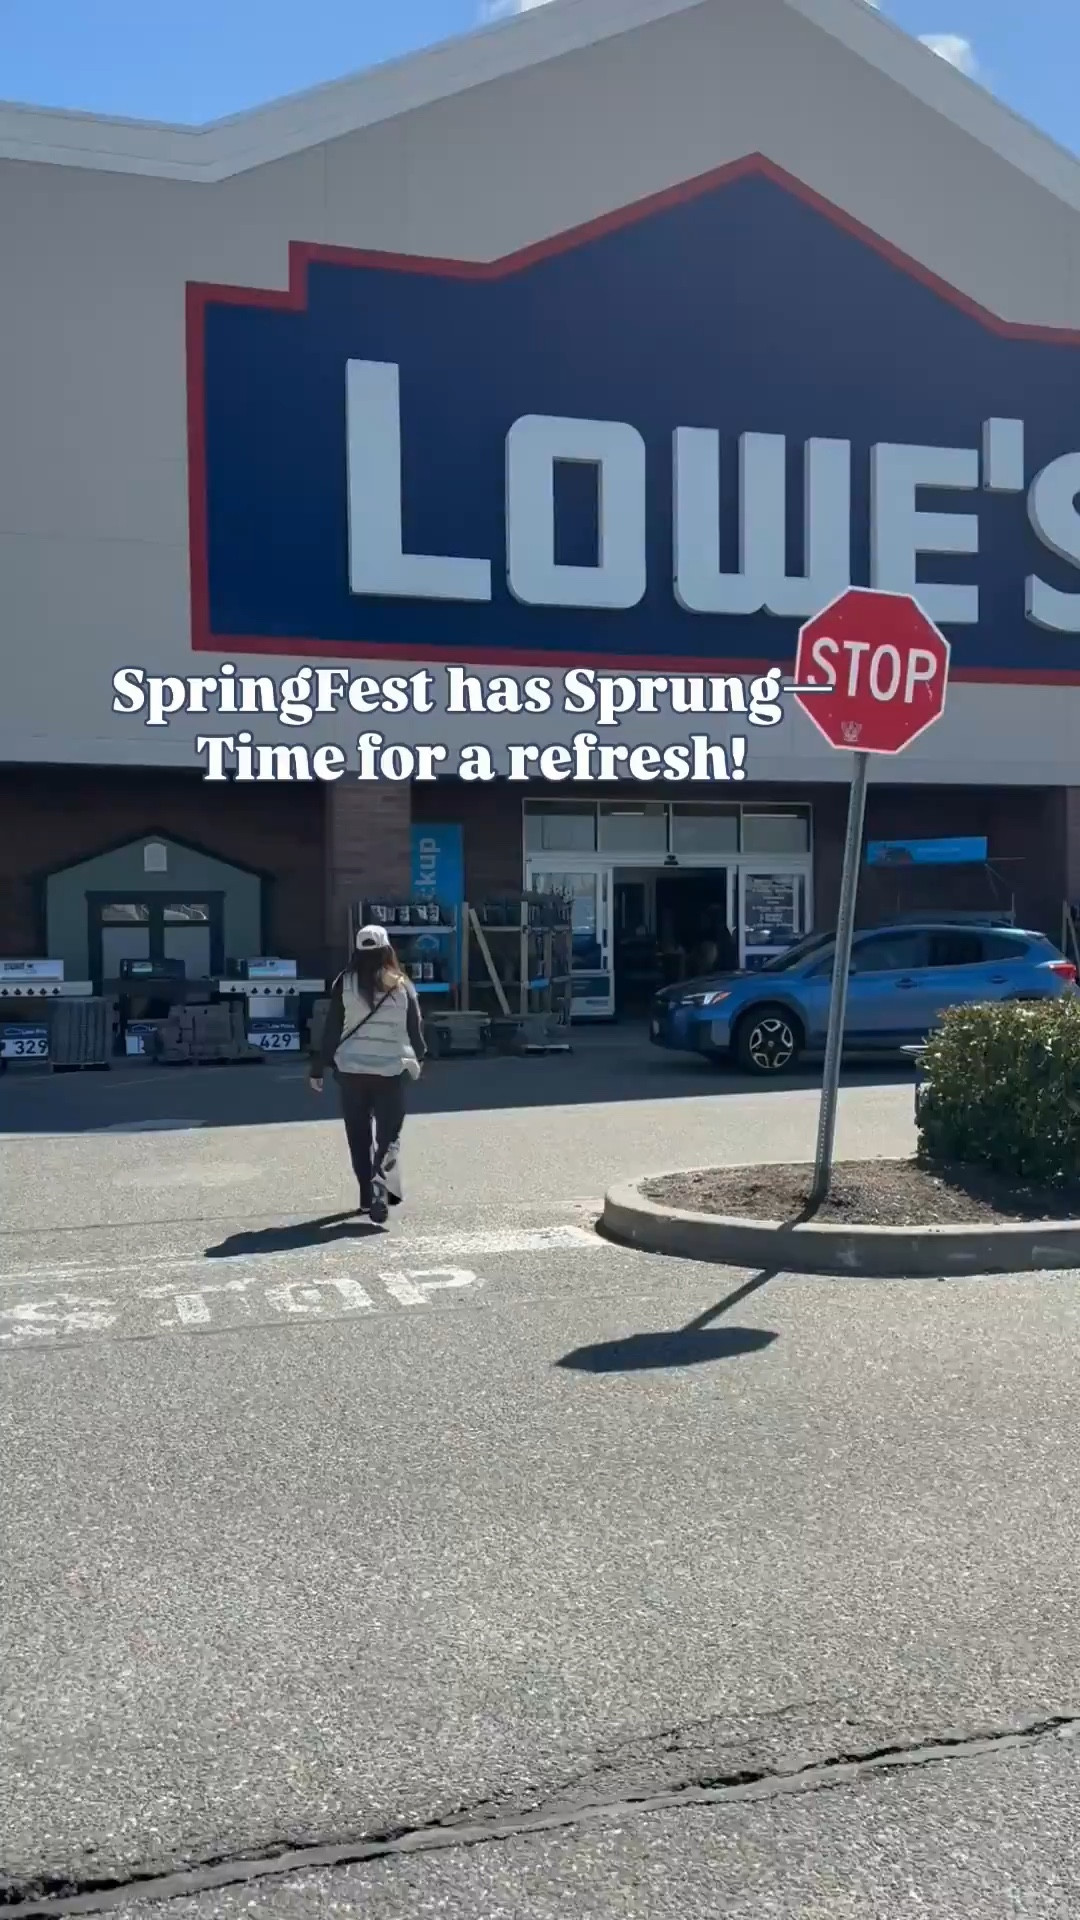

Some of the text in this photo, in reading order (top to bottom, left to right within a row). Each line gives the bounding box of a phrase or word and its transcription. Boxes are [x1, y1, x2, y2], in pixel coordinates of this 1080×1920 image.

[806, 636, 937, 704] STOP
[14, 1040, 48, 1055] 329
[260, 1034, 292, 1049] 429
